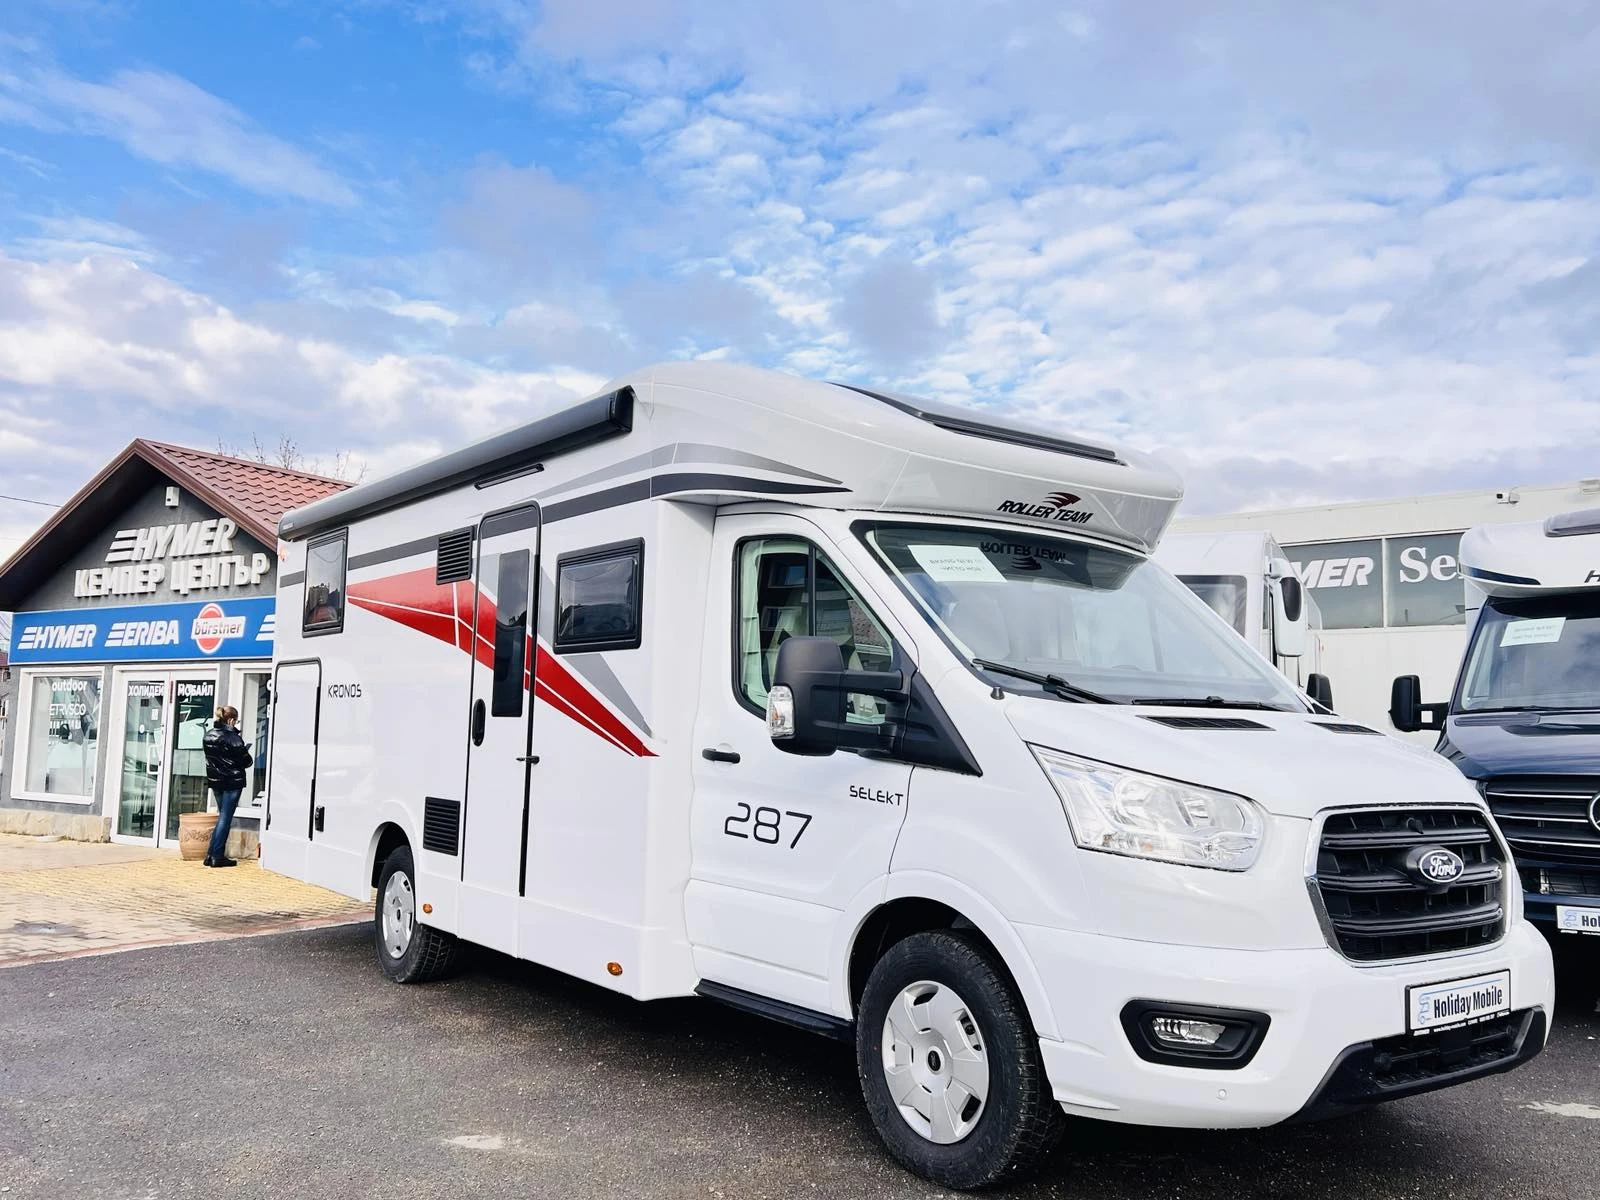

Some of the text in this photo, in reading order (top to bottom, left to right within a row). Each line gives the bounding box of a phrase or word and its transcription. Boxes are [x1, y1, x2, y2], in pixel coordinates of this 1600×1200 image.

[997, 500, 1094, 523] ROLLER TEAM
[131, 517, 237, 562] HYMER
[74, 553, 271, 597] КЕМПЕР ЦЕНТЪР
[1400, 547, 1464, 583] Se
[33, 624, 97, 649] HYMER
[121, 620, 180, 646] ERIBA
[194, 620, 242, 635] bürstner
[52, 679, 87, 691] outdoor
[328, 684, 362, 698] KRONOS
[850, 785, 904, 806] SELEKT
[724, 802, 812, 849] 287
[1430, 855, 1456, 877] Ford
[1433, 985, 1503, 1019] Holiday Mobile
